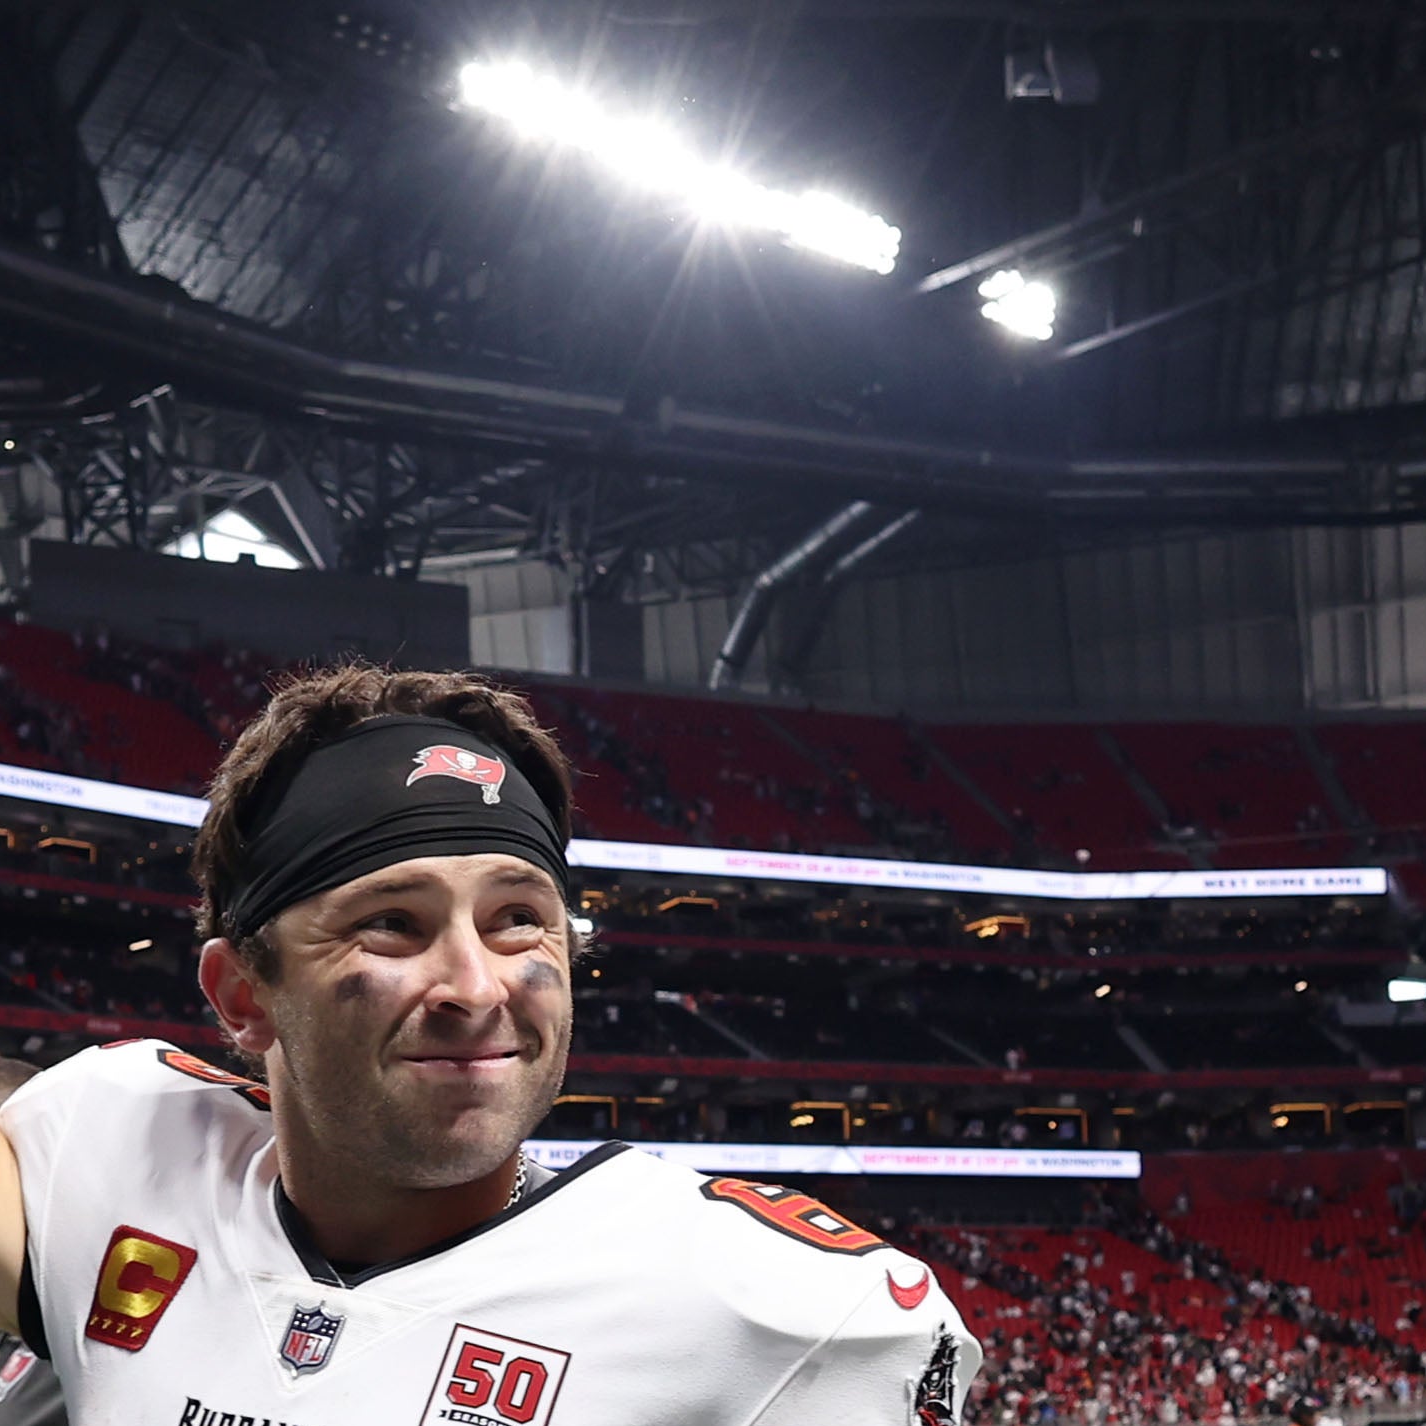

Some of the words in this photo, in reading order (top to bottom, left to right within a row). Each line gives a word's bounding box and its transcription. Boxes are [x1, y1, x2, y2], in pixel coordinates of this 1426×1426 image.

[99, 1237, 180, 1318] C
[285, 1331, 323, 1363] NFL
[446, 1341, 548, 1425] 50
